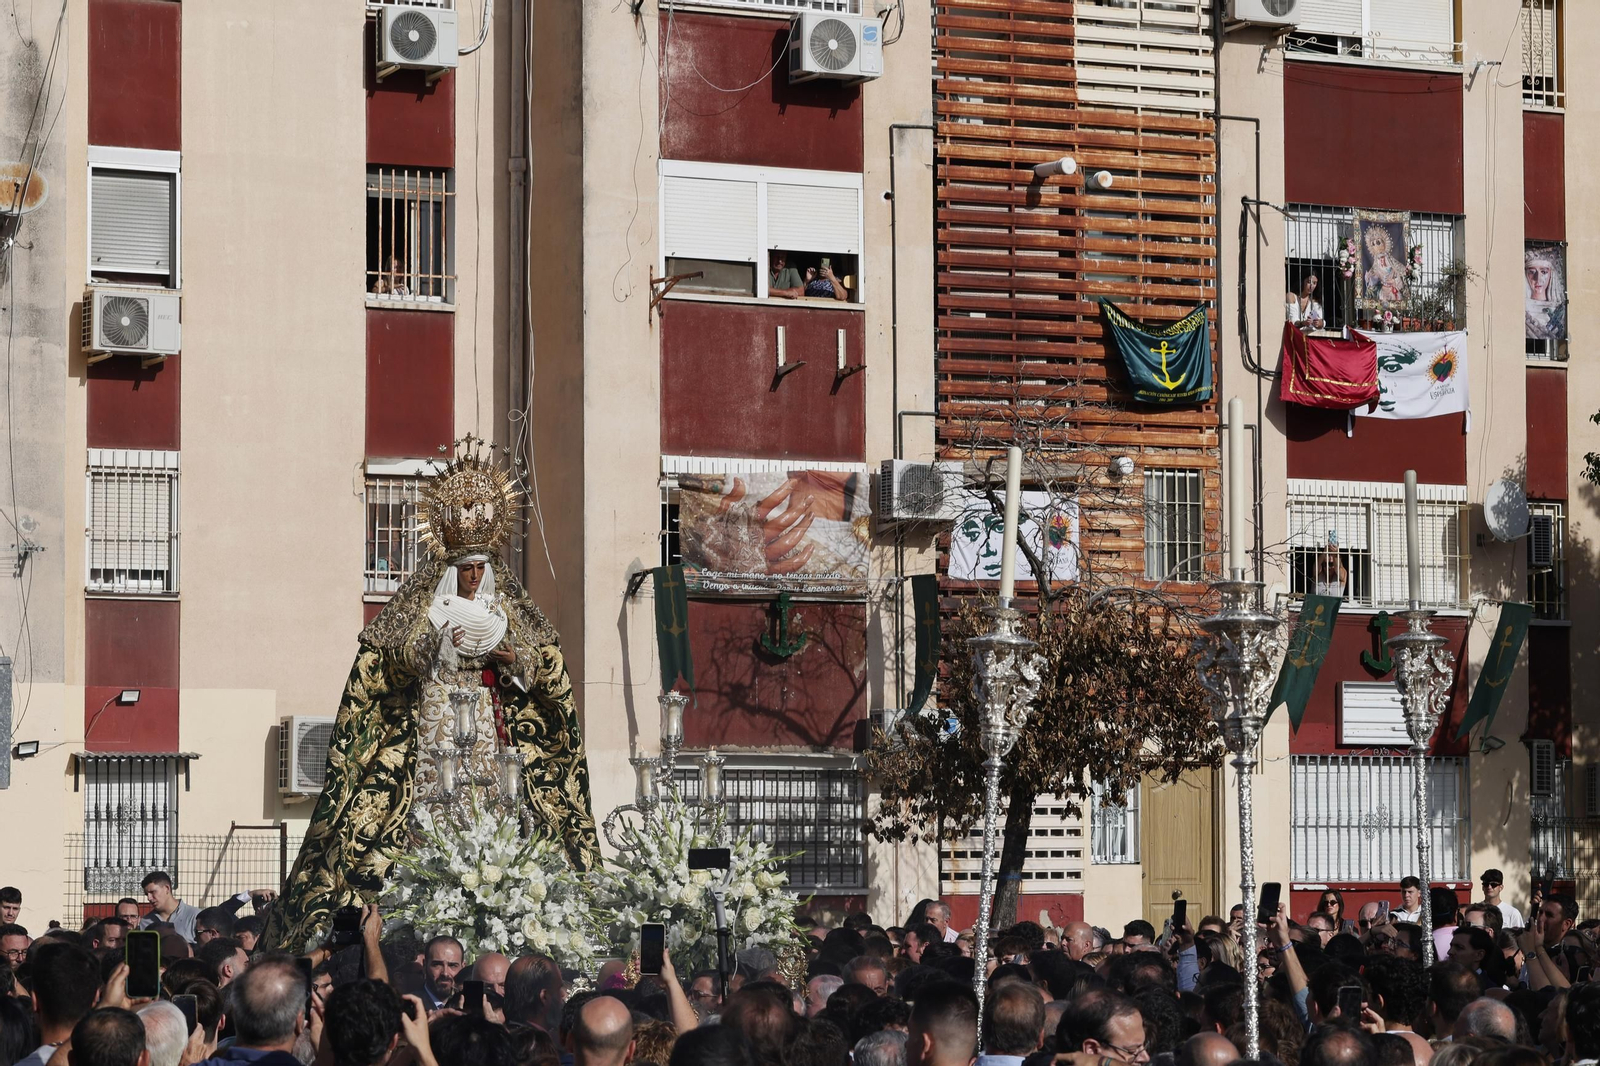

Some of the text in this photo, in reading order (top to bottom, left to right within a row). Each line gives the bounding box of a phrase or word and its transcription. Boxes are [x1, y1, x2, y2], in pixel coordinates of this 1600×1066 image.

[701, 567, 723, 579] Coge
[727, 569, 740, 578] mi
[741, 572, 769, 580] mano,
[786, 572, 812, 582] tengas
[815, 571, 841, 580] miedo
[802, 583, 847, 593] Esperanza
